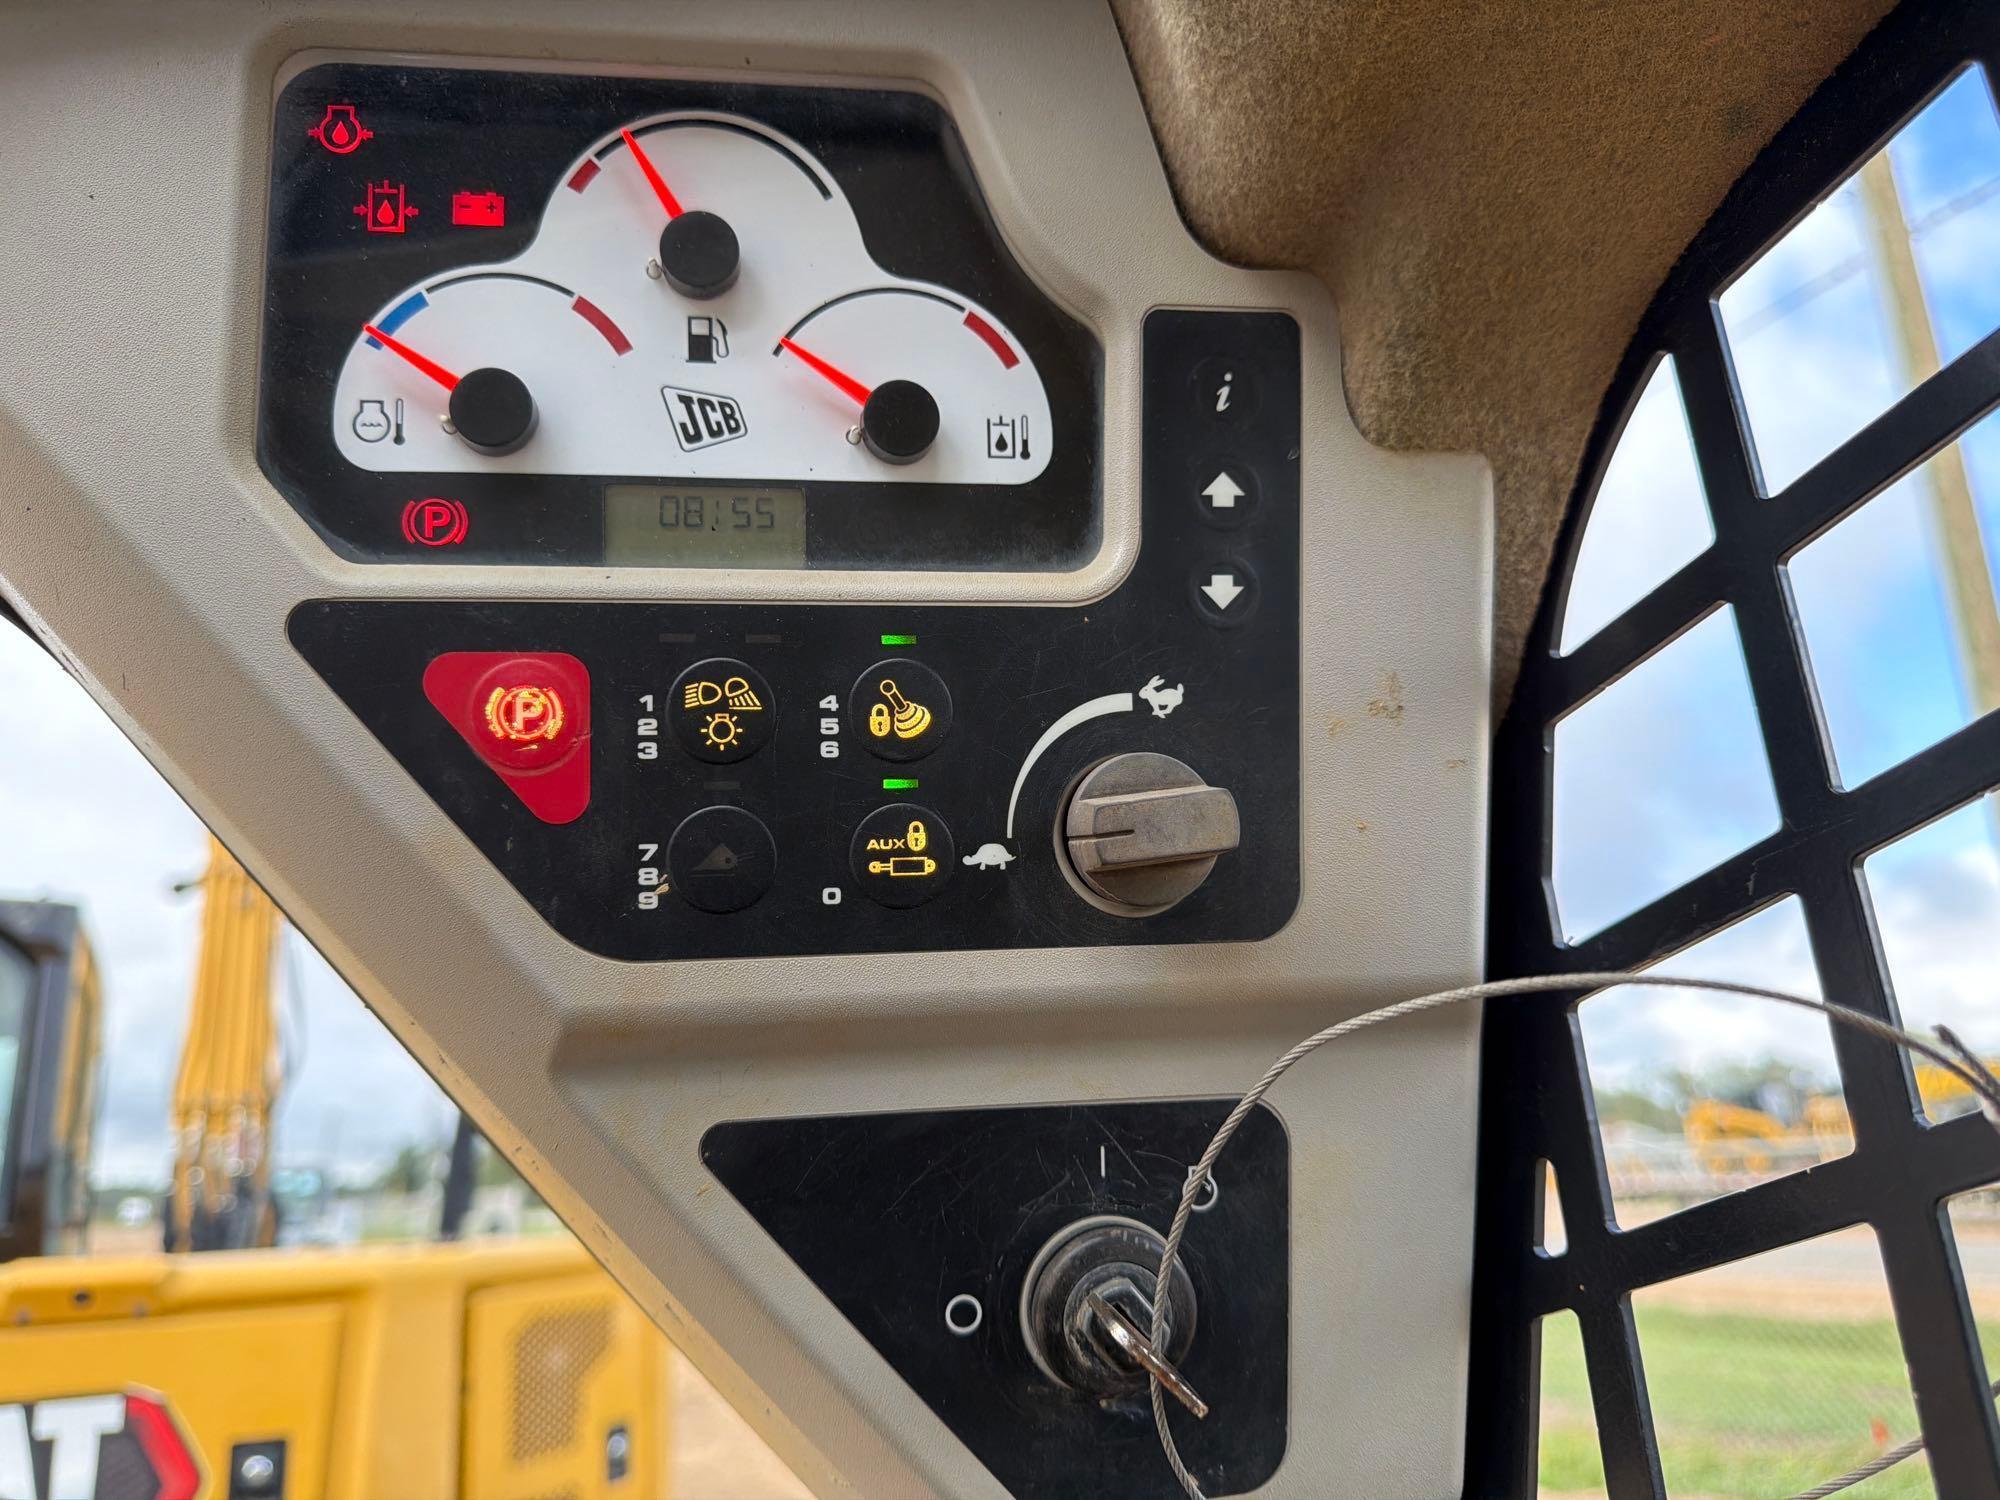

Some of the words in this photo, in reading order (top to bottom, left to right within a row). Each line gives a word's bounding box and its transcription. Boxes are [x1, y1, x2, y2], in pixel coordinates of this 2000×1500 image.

[677, 393, 742, 445] JCB
[659, 495, 775, 528] 08:55
[639, 694, 654, 712] 1
[819, 694, 839, 712] 4
[637, 718, 658, 736] 2
[820, 718, 840, 735] 5
[637, 742, 658, 760] 3
[820, 741, 840, 758] 6
[638, 843, 659, 862] 7
[866, 838, 906, 850] AUX
[638, 867, 659, 886] 8
[638, 891, 659, 910] 9
